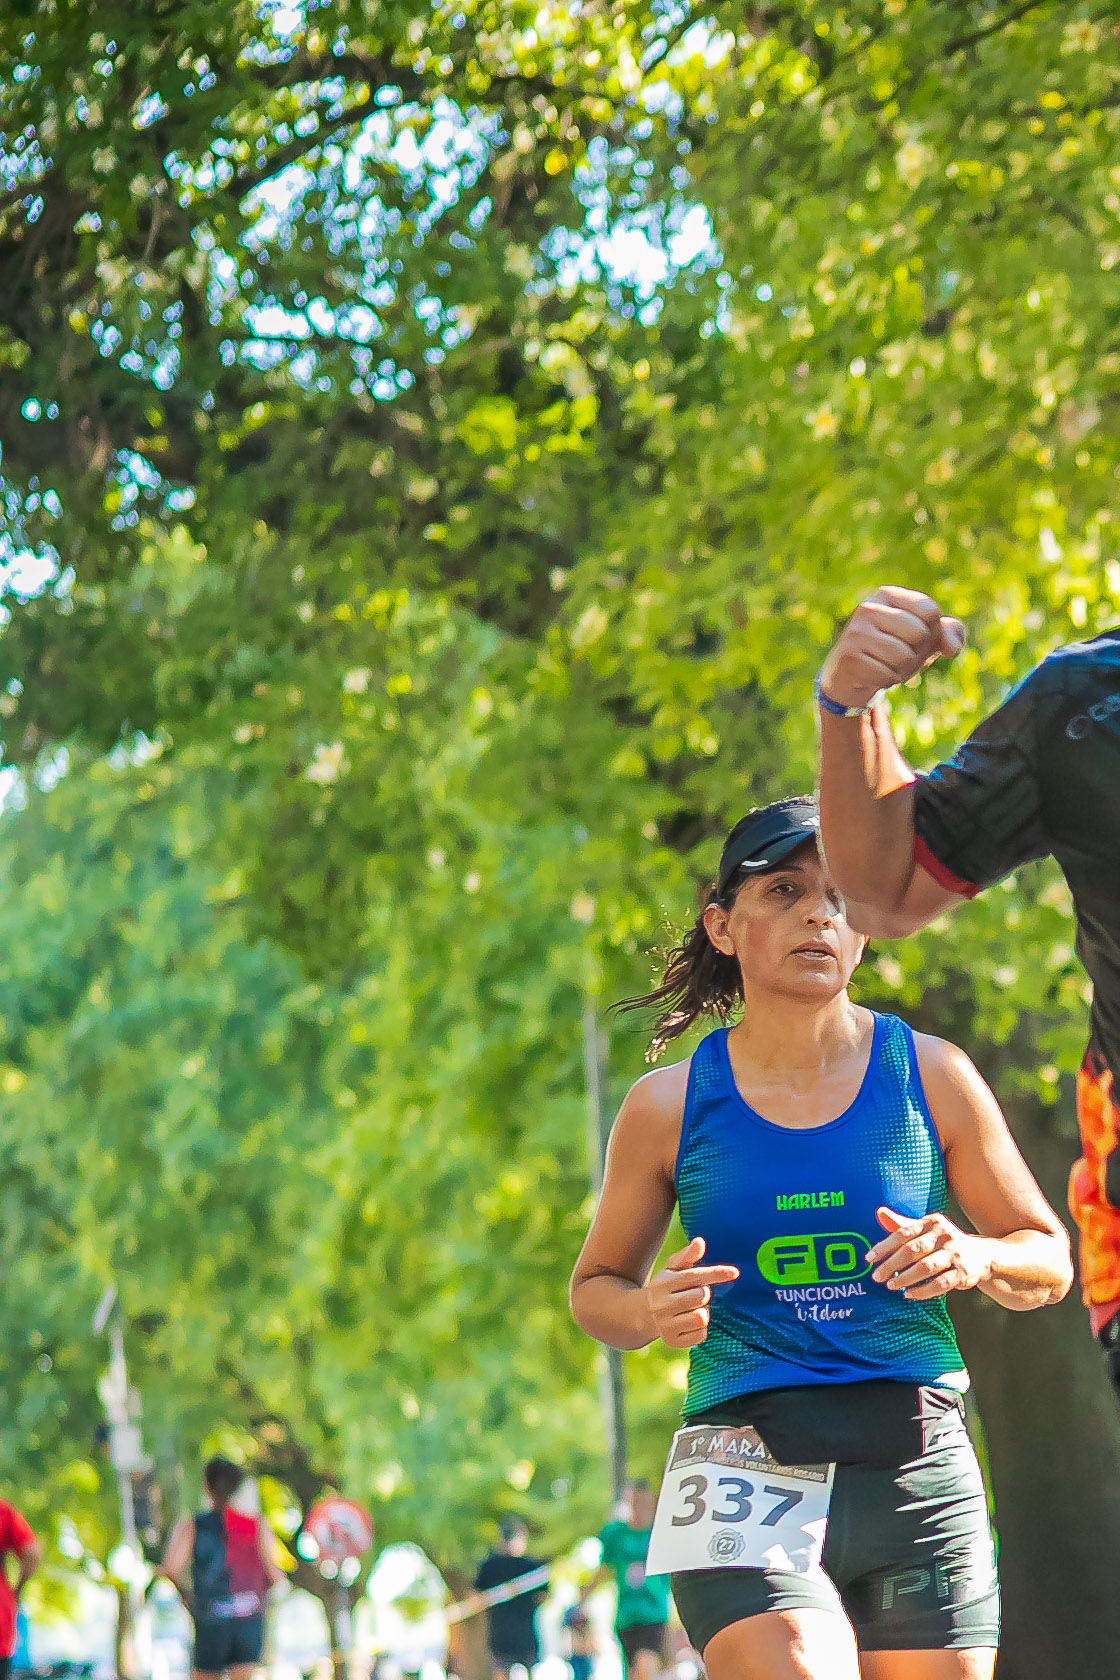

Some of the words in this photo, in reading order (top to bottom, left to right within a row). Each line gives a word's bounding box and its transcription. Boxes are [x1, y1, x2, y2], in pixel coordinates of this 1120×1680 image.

[776, 1191, 844, 1210] HARLEM
[775, 1283, 866, 1301] FUNCIONAL
[708, 1435, 772, 1459] MARA
[672, 1475, 804, 1527] 337
[718, 1538, 735, 1552] 27
